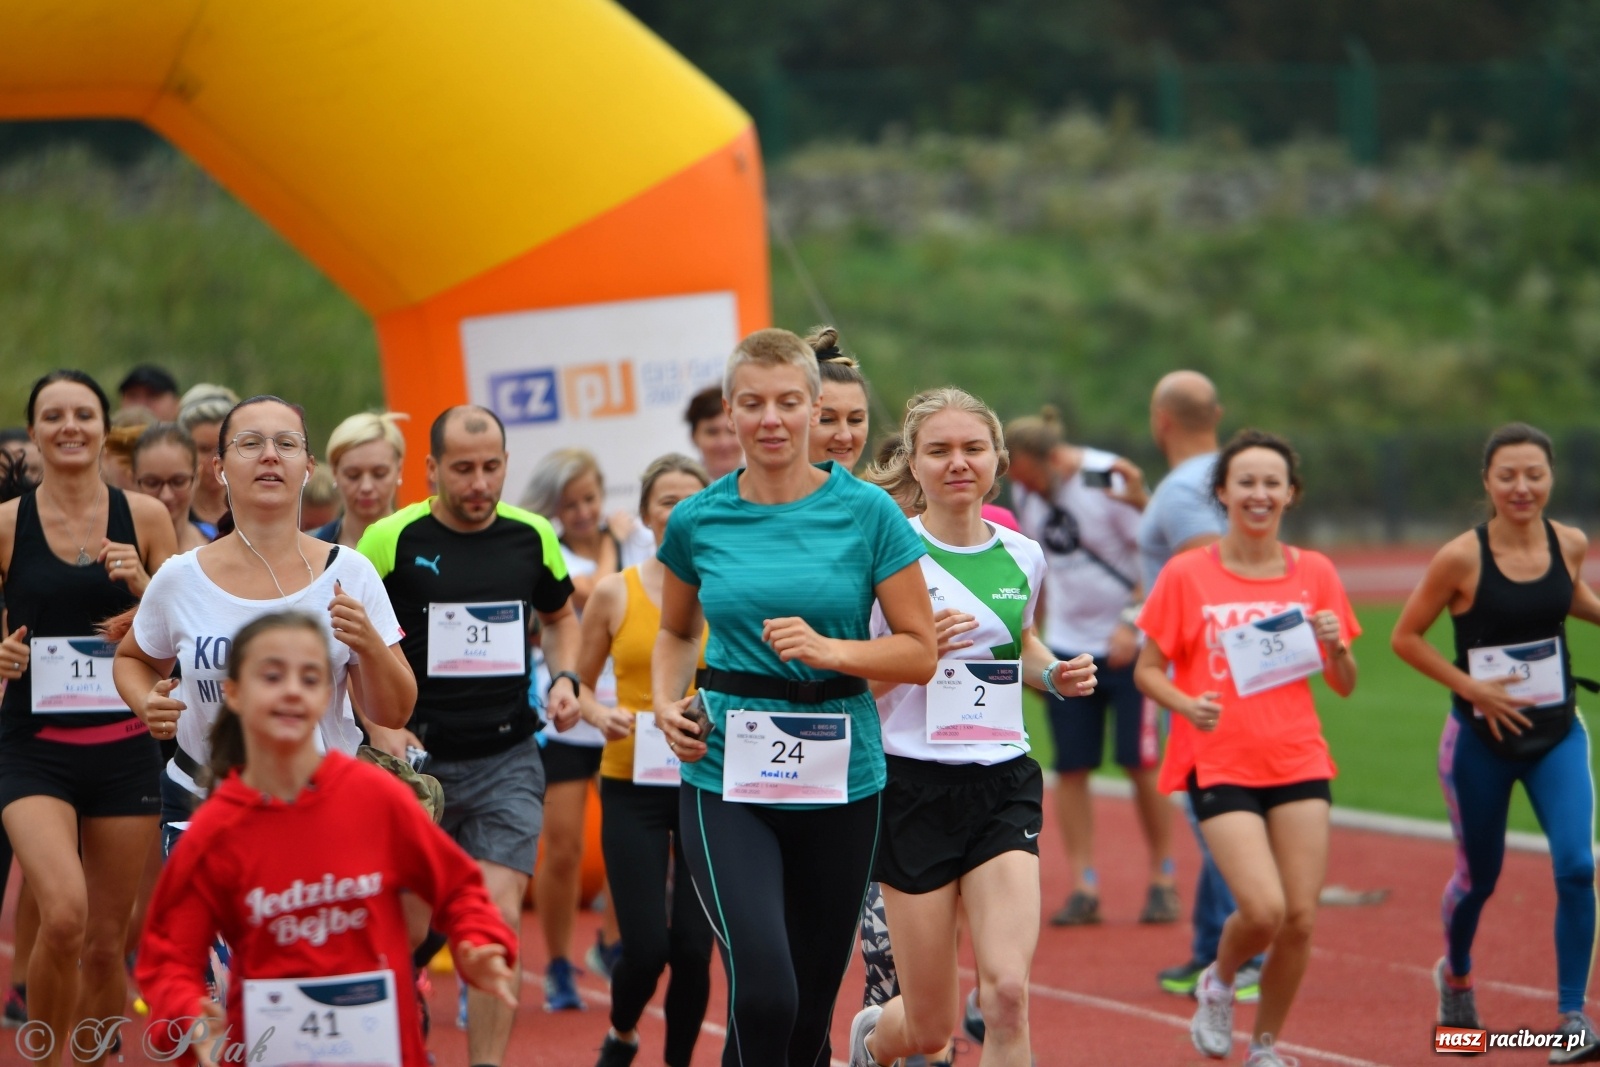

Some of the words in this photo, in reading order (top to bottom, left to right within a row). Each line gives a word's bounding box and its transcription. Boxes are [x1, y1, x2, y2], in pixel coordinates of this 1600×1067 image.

[466, 624, 492, 644] 31
[1259, 633, 1285, 657] 35
[195, 636, 232, 670] KO
[70, 658, 97, 679] 11
[973, 685, 986, 707] 2
[770, 740, 805, 764] 24
[268, 906, 369, 947] Bejbe
[299, 1009, 341, 1038] 41
